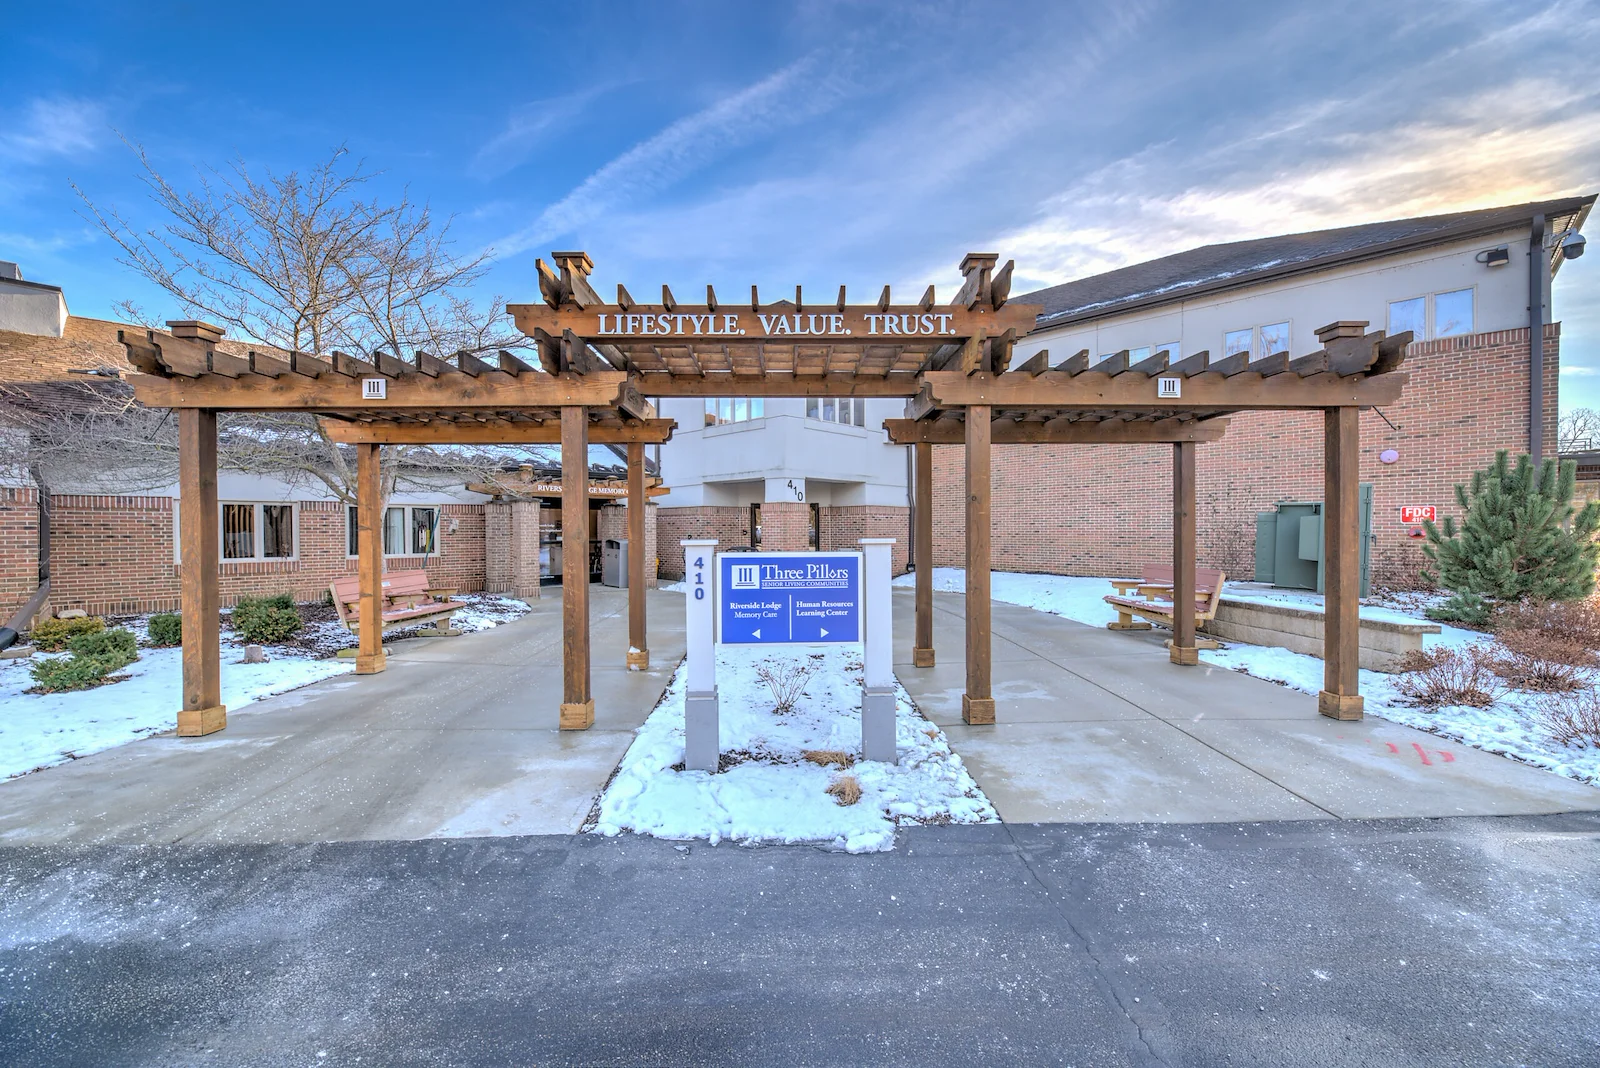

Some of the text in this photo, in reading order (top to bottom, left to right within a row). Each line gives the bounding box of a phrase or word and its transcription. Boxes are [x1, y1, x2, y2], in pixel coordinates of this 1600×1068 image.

[597, 313, 956, 335] LIFESTYLE. VALUE. TRUST.
[787, 479, 803, 501] 410
[1405, 507, 1431, 517] FDC
[761, 563, 849, 579] Three Pillars
[693, 556, 704, 600] 410
[761, 602, 782, 610] Lodge
[734, 611, 761, 619] Memory
[796, 609, 825, 618] Learning
